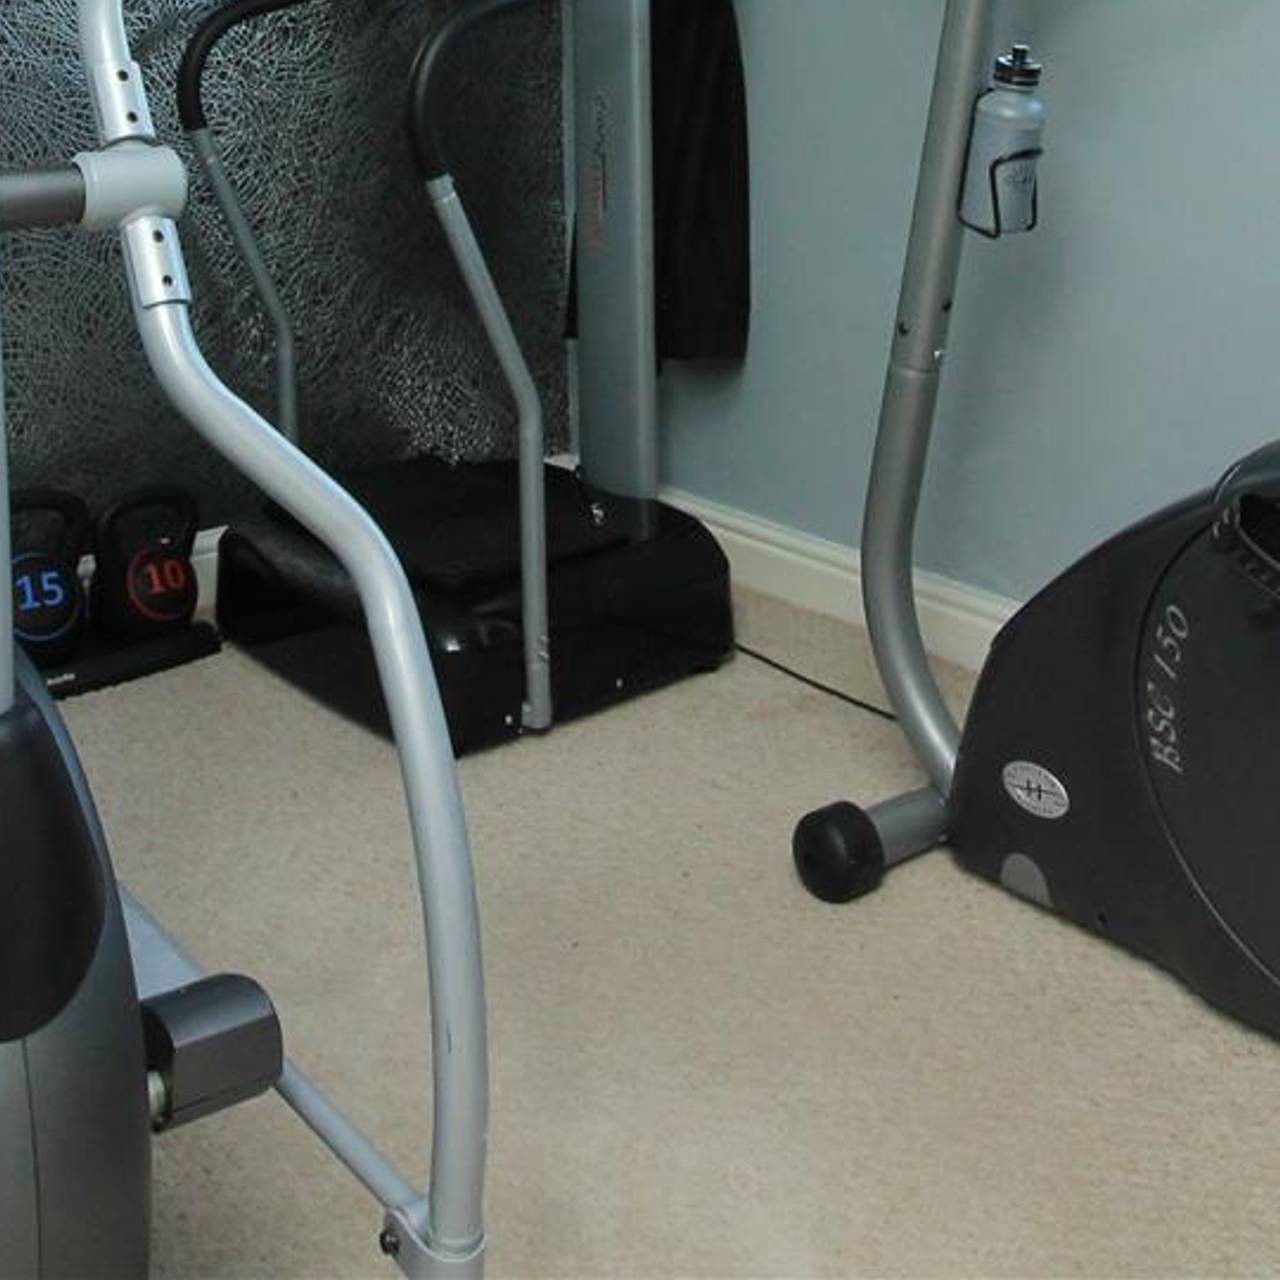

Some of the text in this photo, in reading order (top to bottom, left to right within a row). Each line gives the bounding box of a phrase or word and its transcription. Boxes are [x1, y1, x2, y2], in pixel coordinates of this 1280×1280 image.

[16, 571, 65, 611] 15
[145, 559, 187, 595] 10
[1153, 604, 1189, 678] 150
